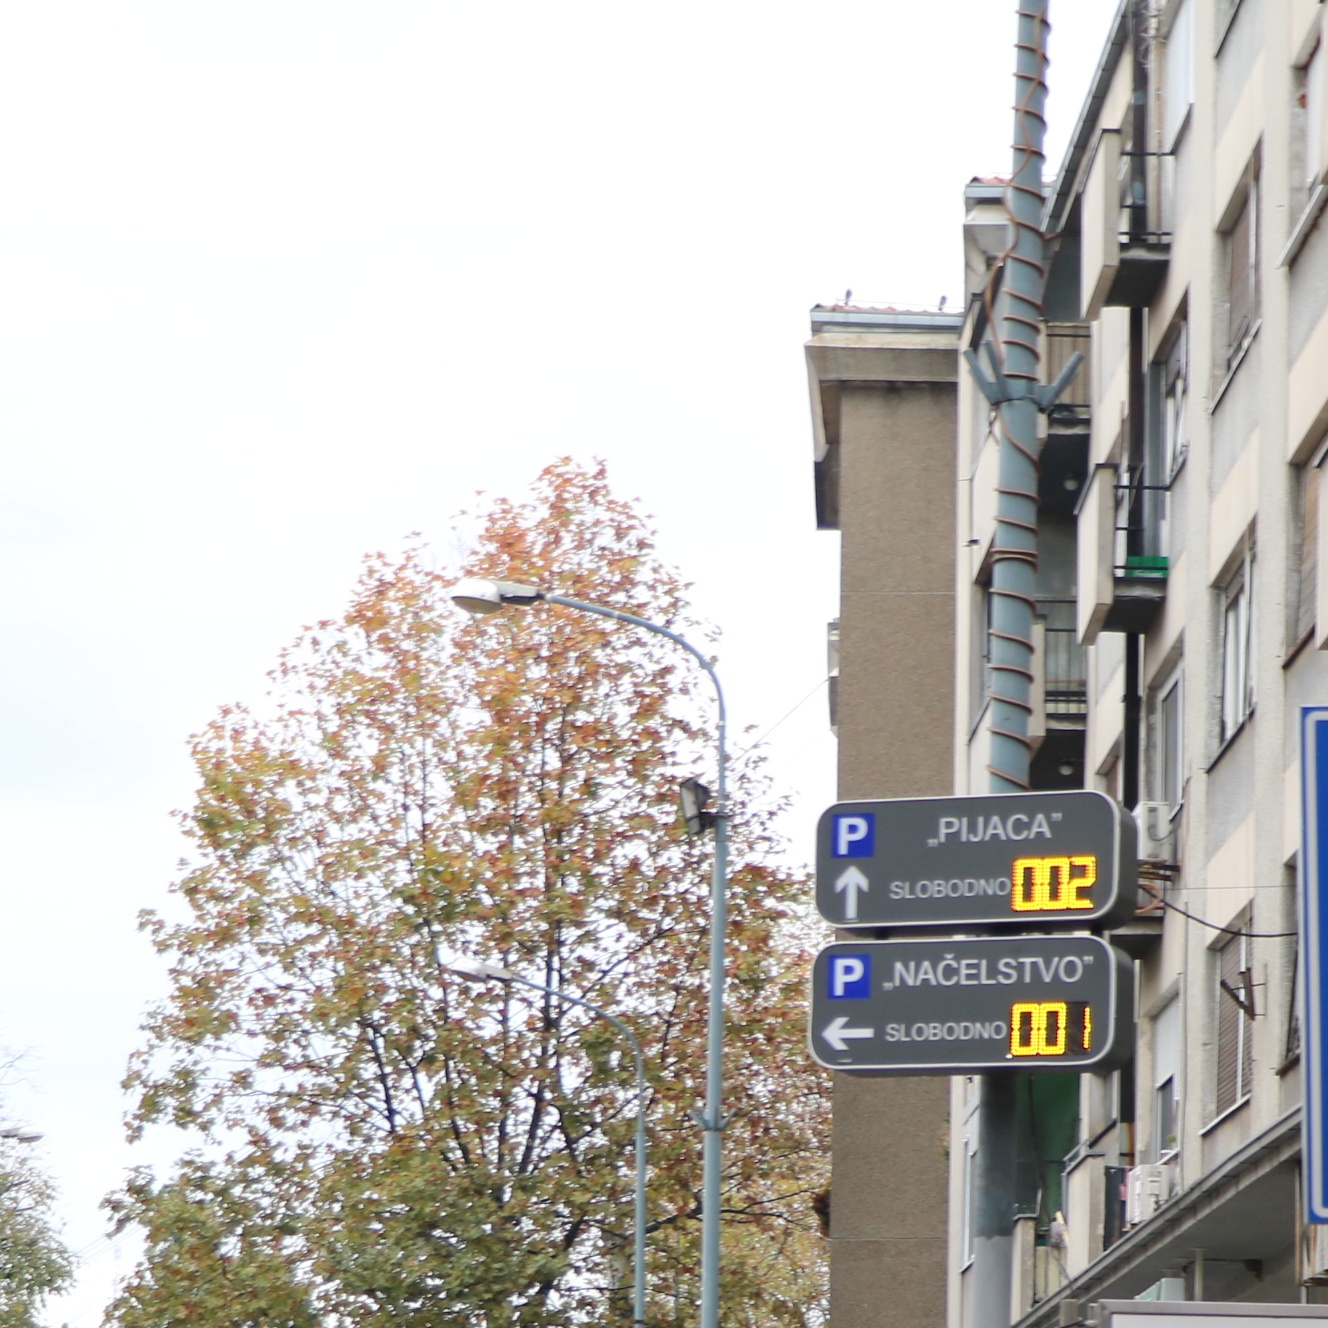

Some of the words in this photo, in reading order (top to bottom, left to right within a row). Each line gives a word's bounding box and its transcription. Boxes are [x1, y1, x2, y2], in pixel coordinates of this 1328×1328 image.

[837, 817, 869, 856] P
[889, 878, 1010, 900] SLOBODNO
[1011, 855, 1097, 912] 002
[833, 957, 865, 997] P
[884, 1020, 1008, 1042] SLOBODNO
[1010, 1001, 1092, 1057] 001
